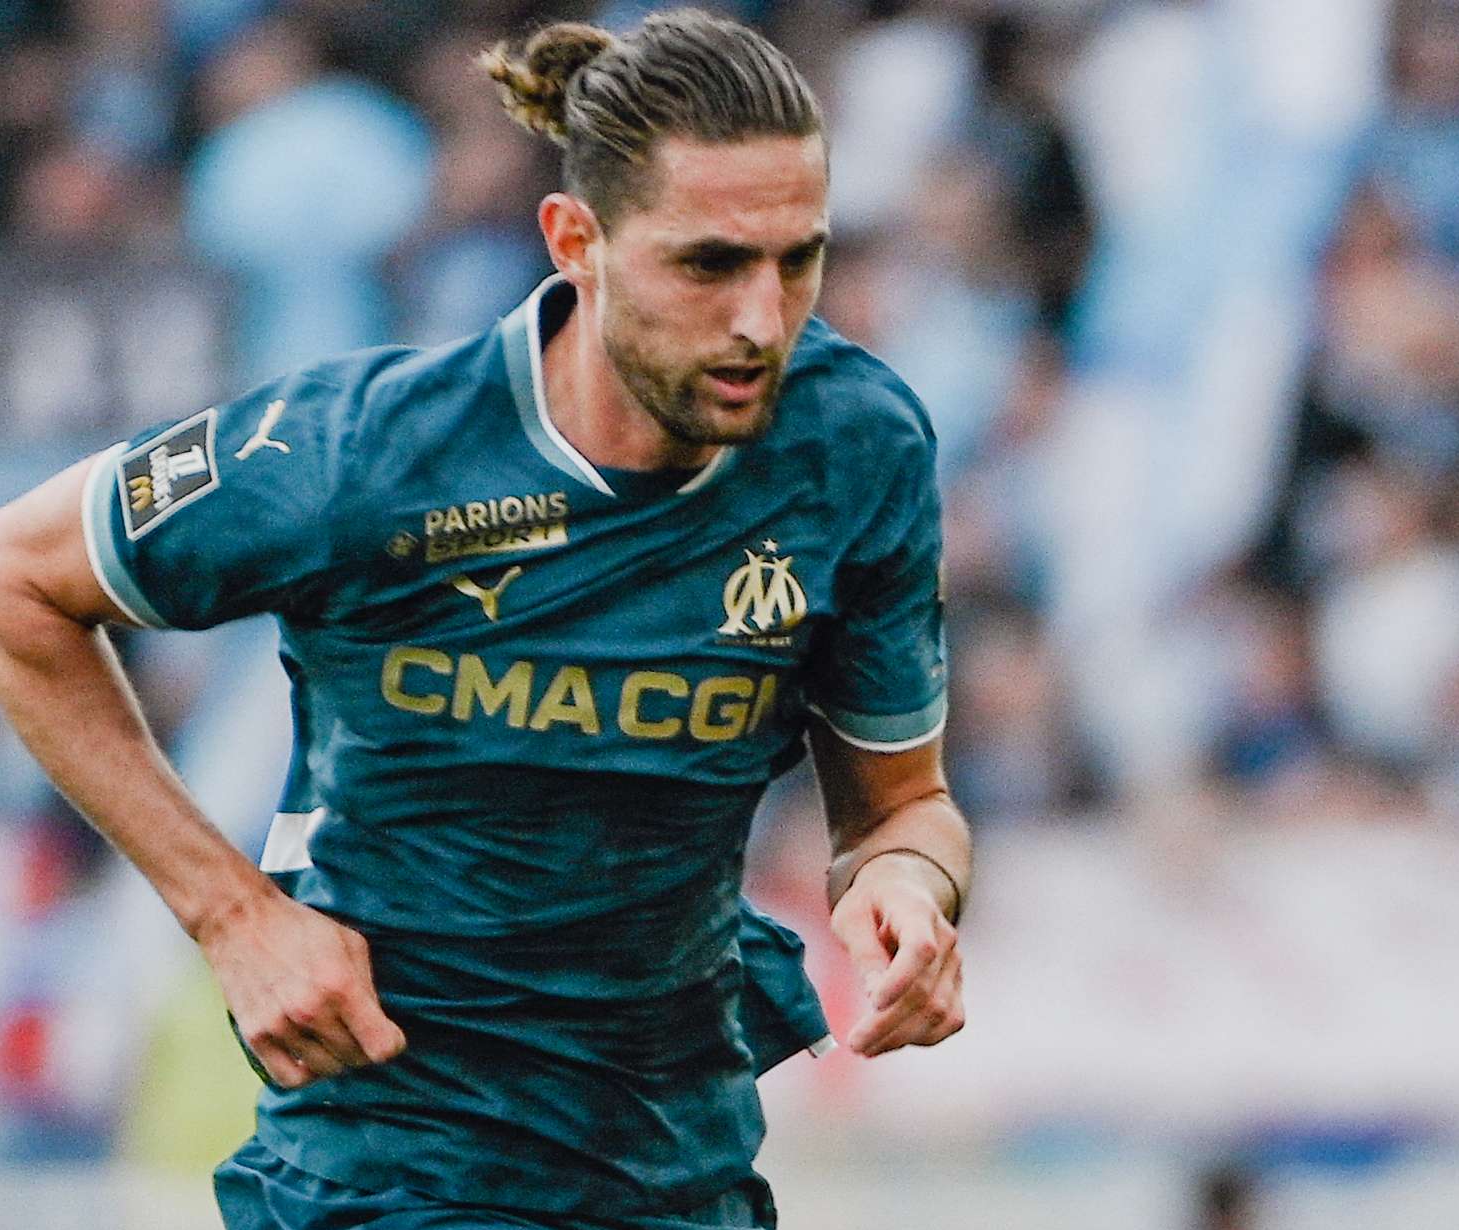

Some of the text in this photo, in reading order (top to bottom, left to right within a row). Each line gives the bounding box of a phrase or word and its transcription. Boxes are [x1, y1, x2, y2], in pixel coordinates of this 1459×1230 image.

[425, 490, 569, 536] PARIONS
[380, 645, 777, 742] CMA CG
